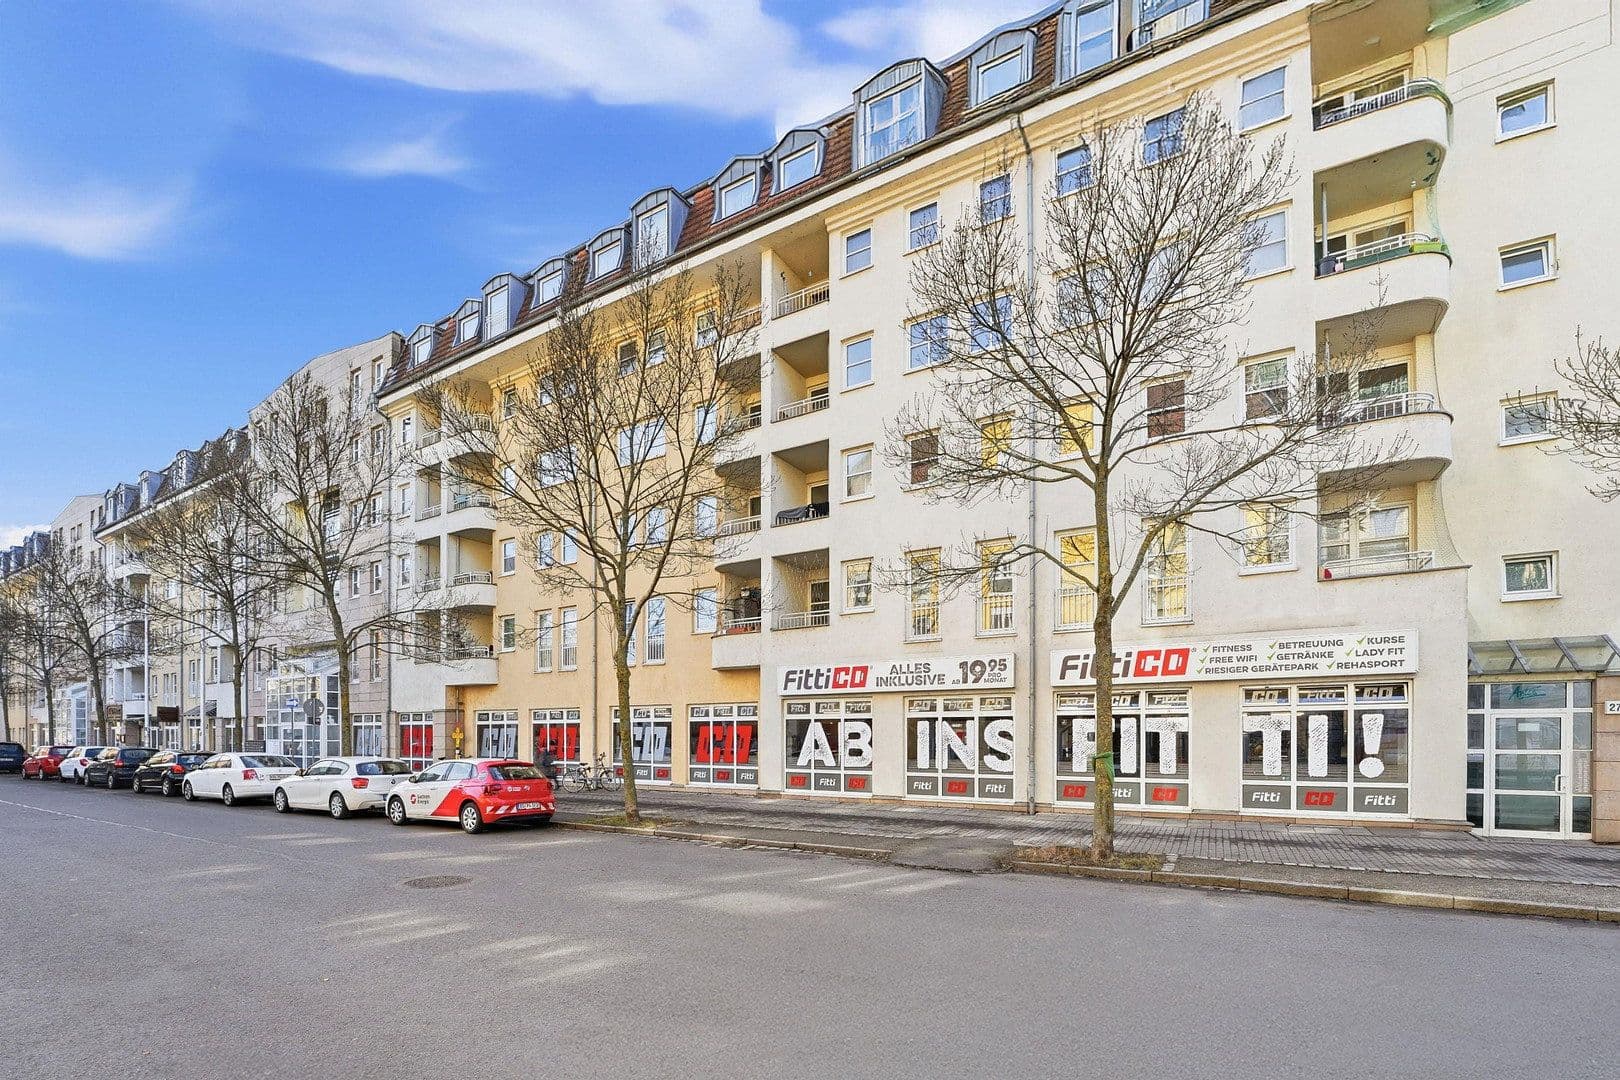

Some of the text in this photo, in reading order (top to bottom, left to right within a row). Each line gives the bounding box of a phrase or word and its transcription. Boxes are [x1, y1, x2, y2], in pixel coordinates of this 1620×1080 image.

[1278, 639, 1344, 650] BETREUUNG
[1367, 636, 1405, 645] KURSE
[1212, 644, 1252, 653] FITNESS
[1355, 647, 1405, 657] LADY FIT
[1209, 654, 1257, 664] FREE WIFI
[1276, 650, 1334, 661] GETRÄNKE
[890, 663, 931, 675] ALLES
[1205, 662, 1318, 674] RIESIGER GERÄTEPARK
[1336, 660, 1405, 670] REHASPORT
[875, 673, 945, 687] INKLUSIVE
[1609, 703, 1620, 712] 27
[797, 721, 872, 767] AB
[917, 719, 1013, 772] INS
[913, 781, 1006, 793] Fitti Fitti
[1252, 791, 1281, 802] Fitti
[1364, 795, 1396, 806] Fitti
